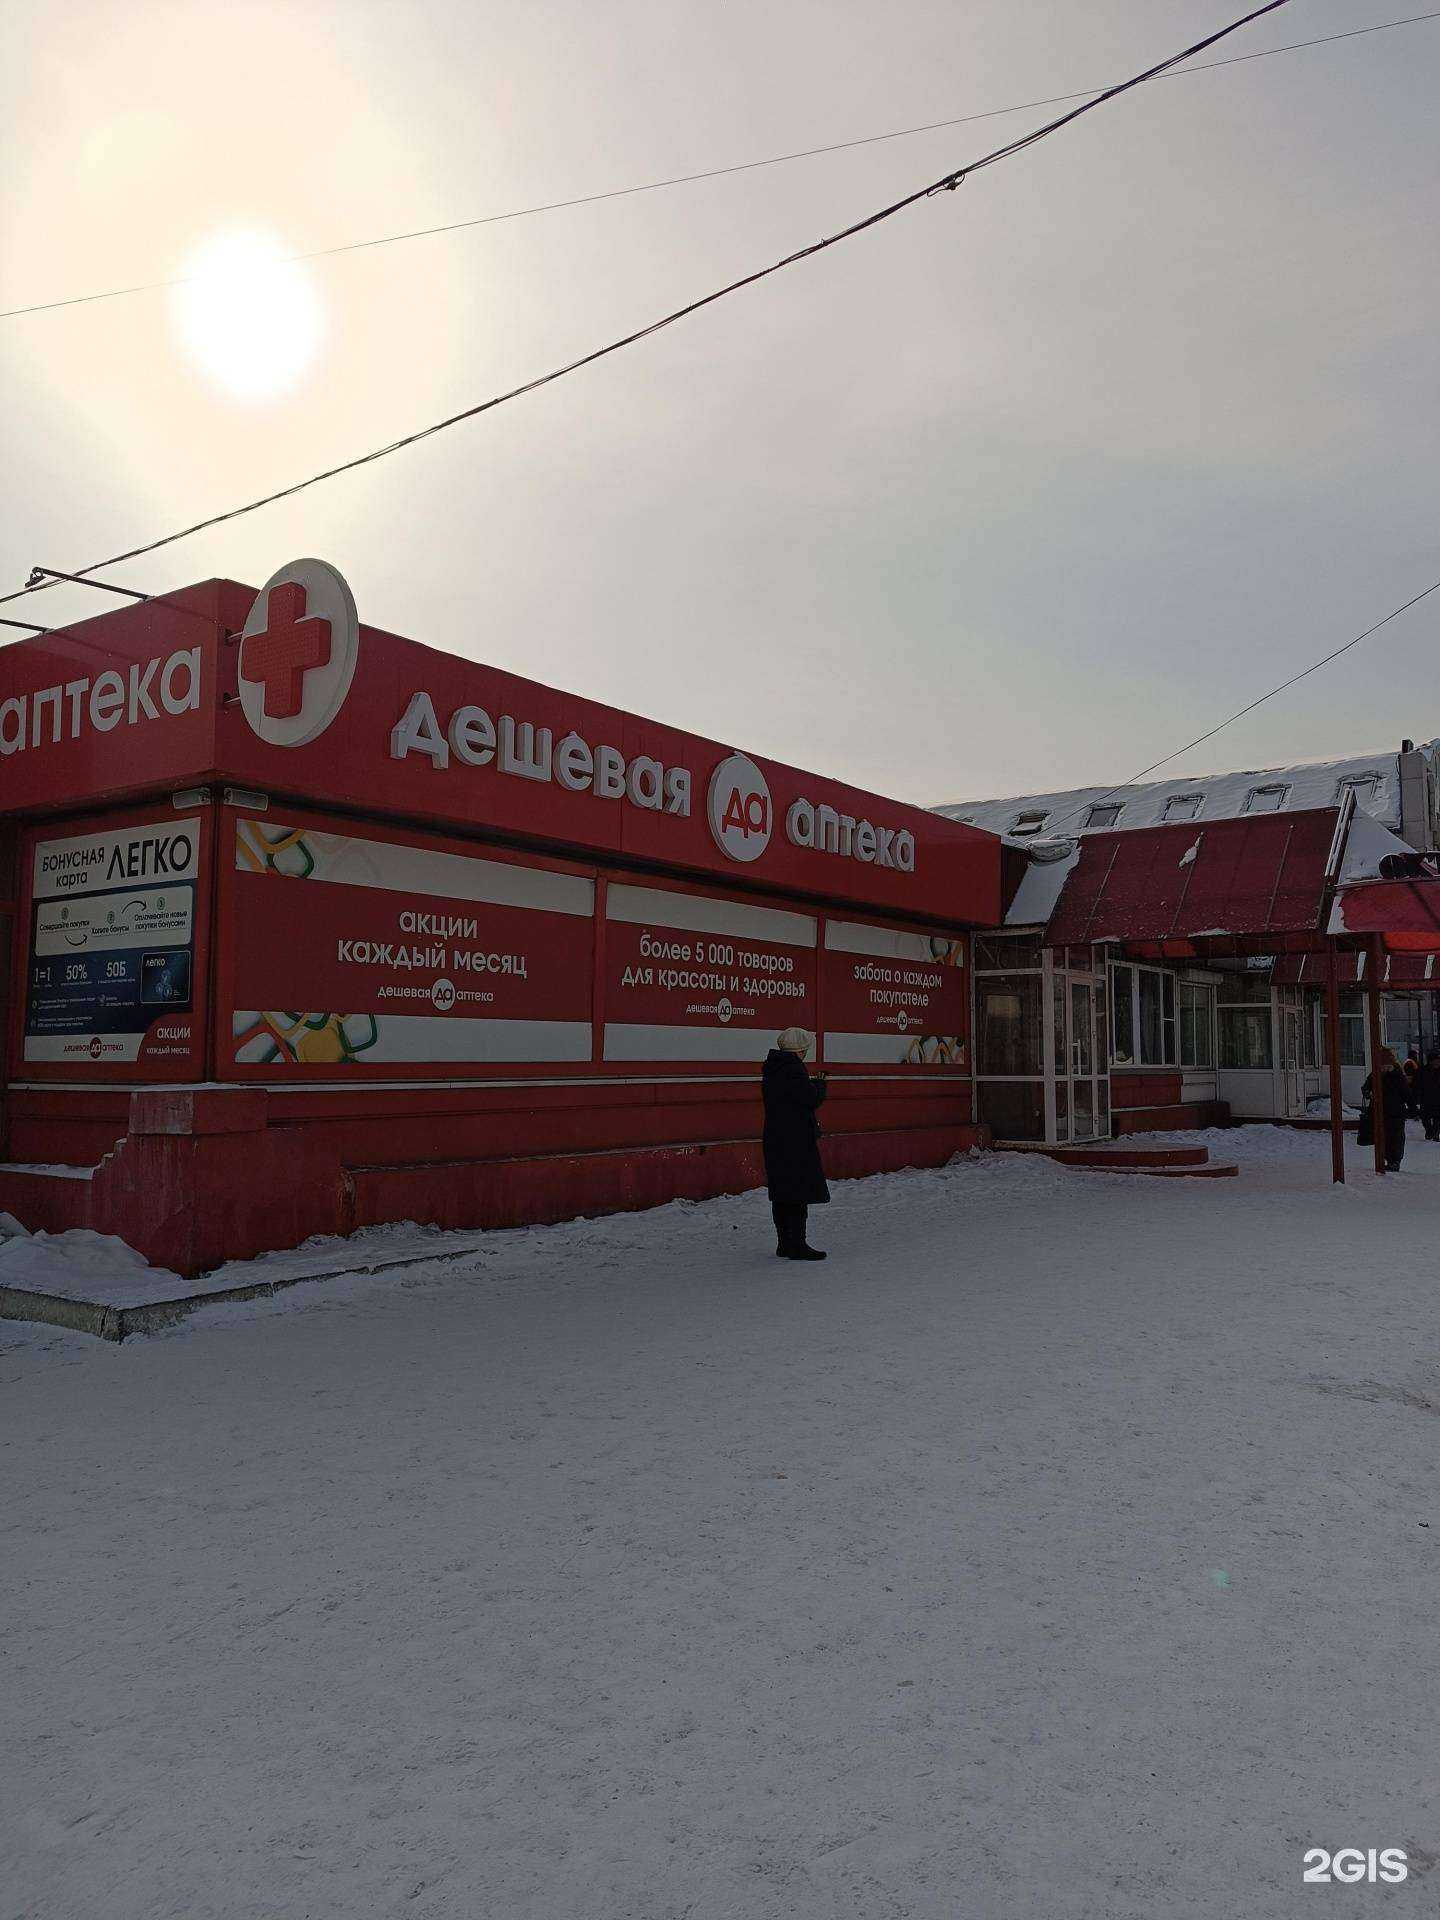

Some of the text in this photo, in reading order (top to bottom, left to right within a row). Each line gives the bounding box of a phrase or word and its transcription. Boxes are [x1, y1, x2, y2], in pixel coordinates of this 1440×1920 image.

[0, 646, 201, 755] аптека
[786, 797, 916, 871] аптека
[42, 834, 192, 880] БОНУСНАЯ ЛЕГКО
[56, 871, 88, 889] карта
[399, 910, 479, 939] акции
[338, 938, 529, 979] каждый месяц
[640, 932, 794, 973] более 5 000 товаров
[65, 964, 88, 980] 50%
[622, 965, 806, 999] для красоты и здоровья
[854, 964, 942, 988] забота о каждом
[377, 984, 431, 999] дешевая
[456, 990, 494, 1002] аптека
[869, 988, 929, 1009] покупателе
[686, 1003, 718, 1014] дешевая
[732, 1007, 755, 1017] аптека
[157, 1027, 191, 1041] акции
[146, 1046, 190, 1056] каждый месяц
